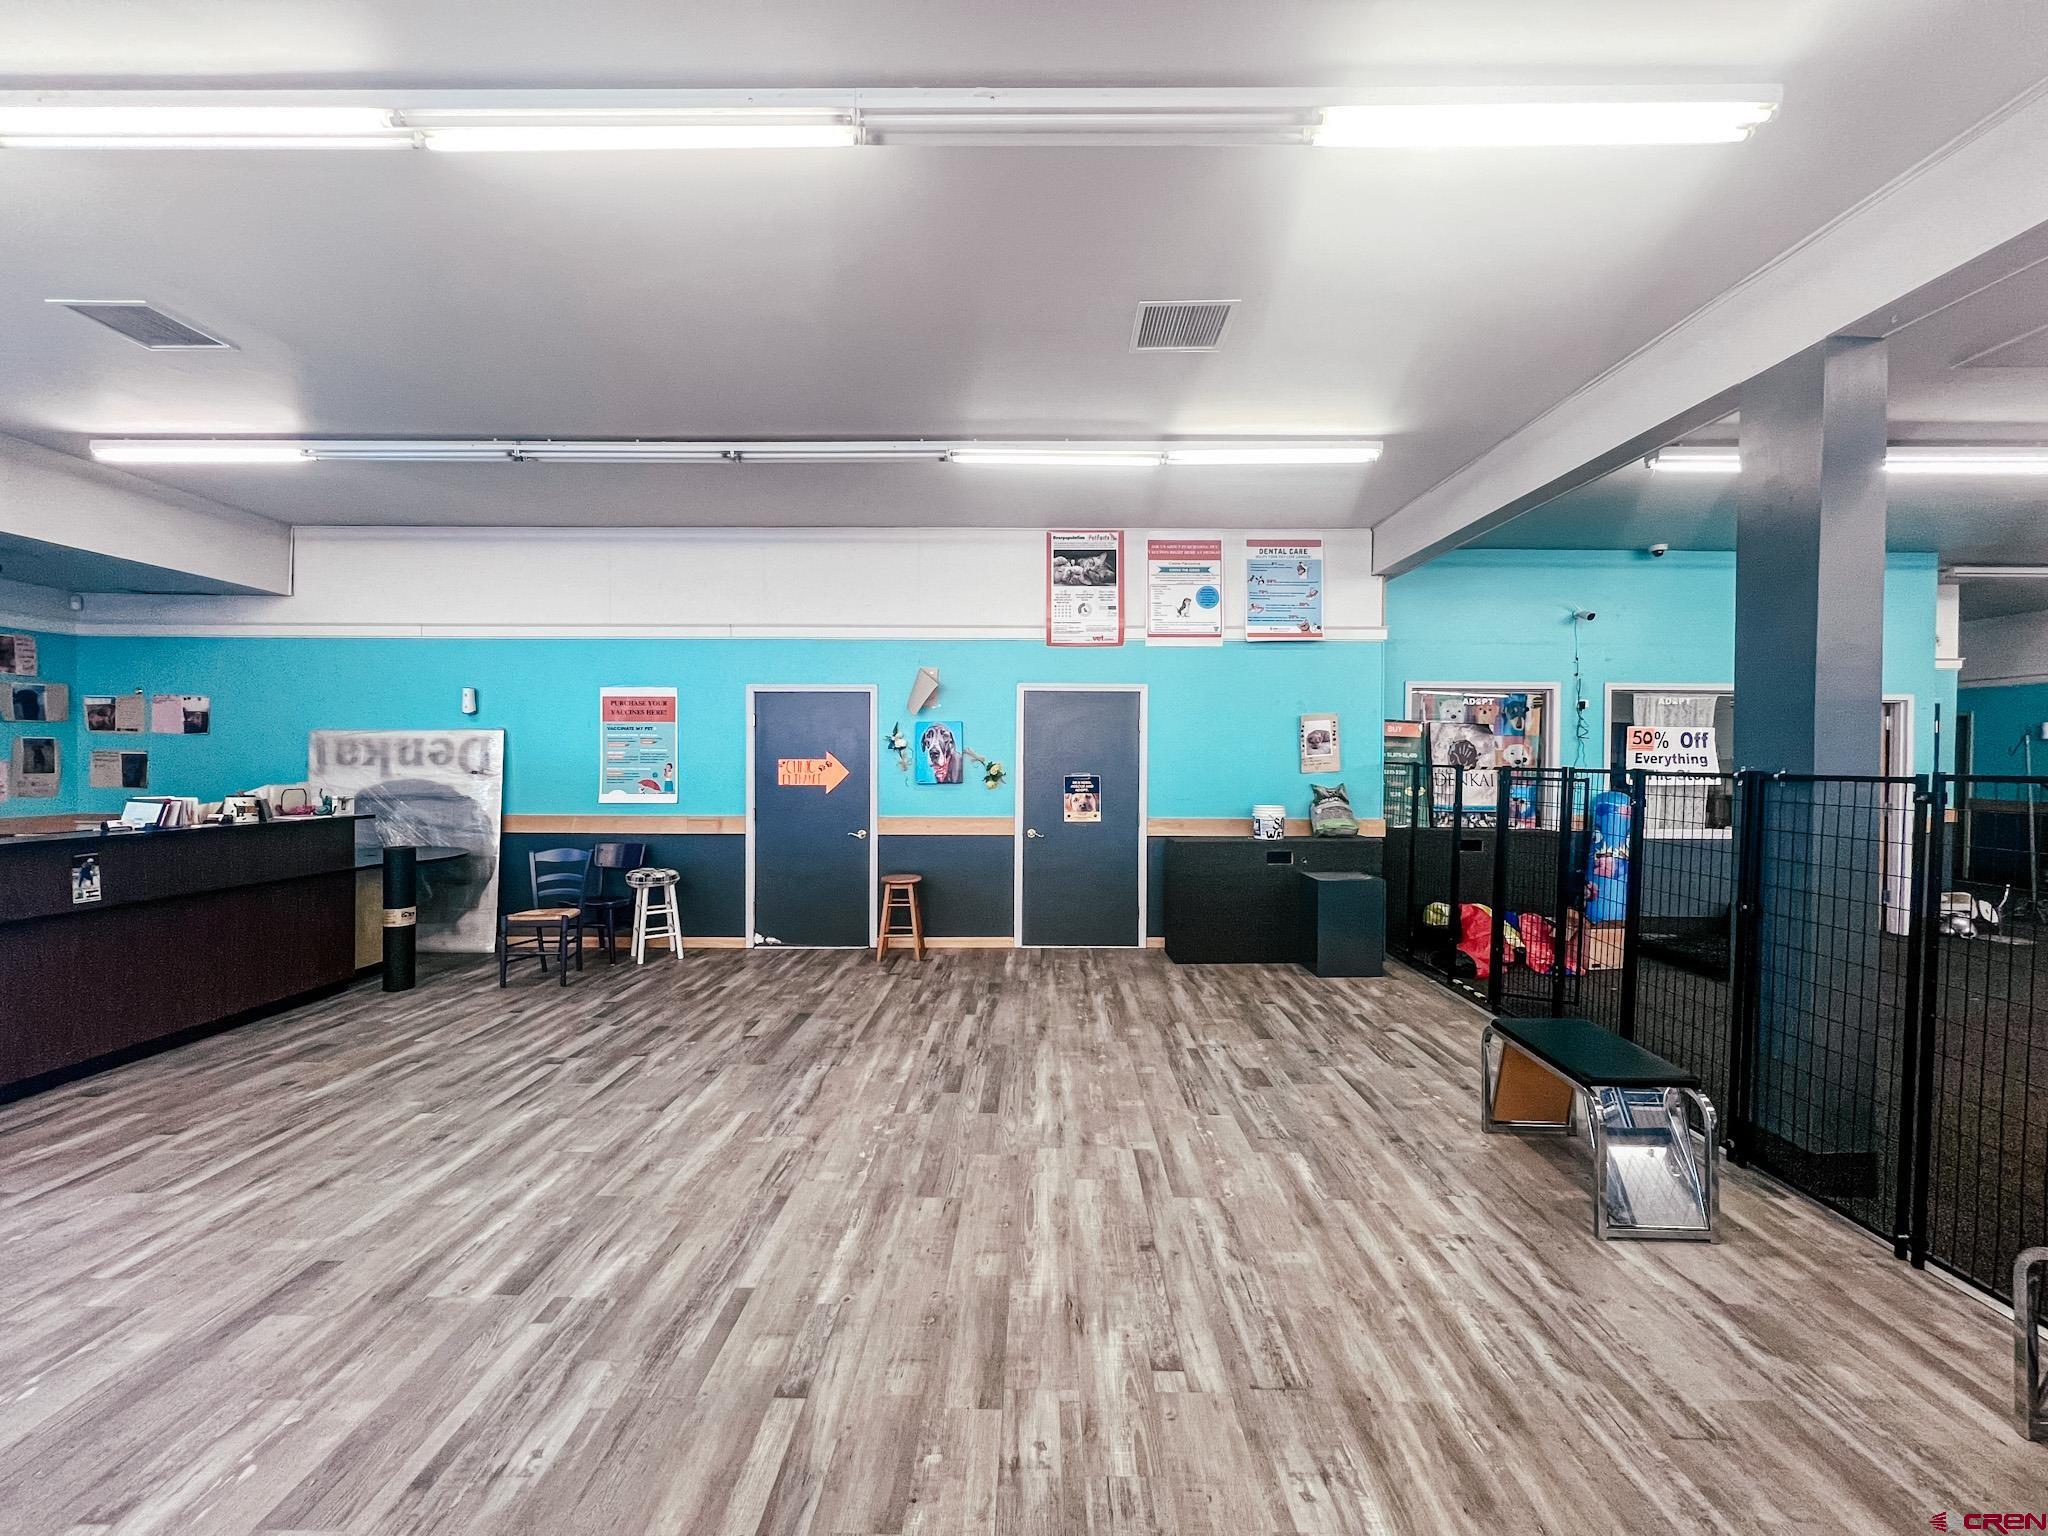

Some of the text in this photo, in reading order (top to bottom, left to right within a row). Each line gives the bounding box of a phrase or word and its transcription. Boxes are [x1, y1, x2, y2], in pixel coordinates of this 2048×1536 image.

[1386, 725, 1402, 733] BUY
[1632, 730, 1709, 749] 50% Off
[1635, 753, 1708, 767] Everything
